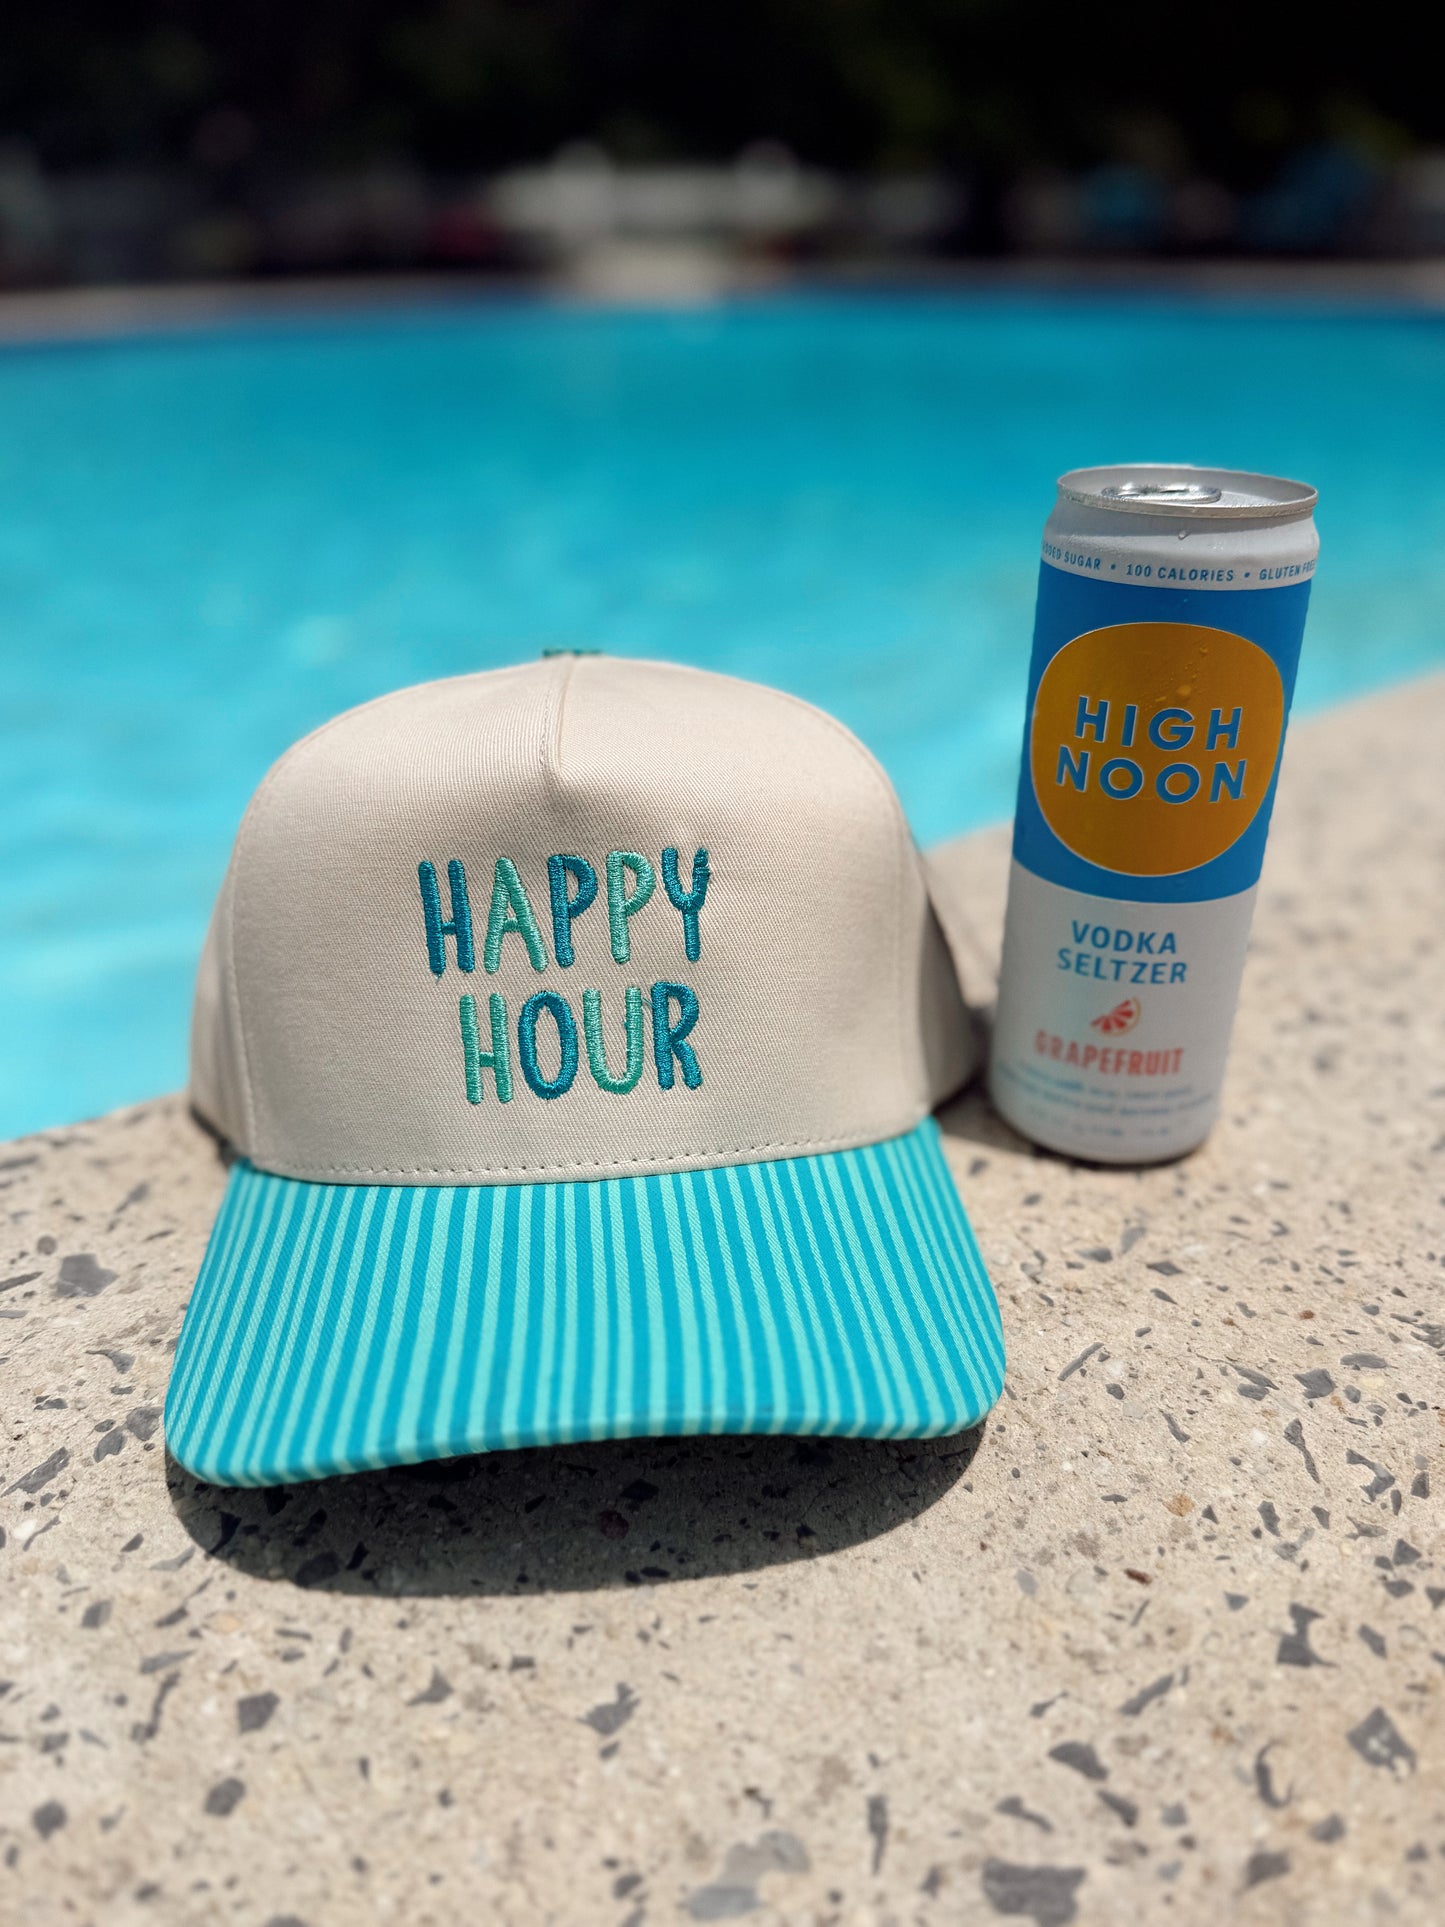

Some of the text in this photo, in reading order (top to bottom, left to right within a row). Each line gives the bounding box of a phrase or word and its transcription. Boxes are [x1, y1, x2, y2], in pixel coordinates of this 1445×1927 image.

[1064, 552, 1101, 570] SUGAR
[1126, 563, 1152, 577] 100
[1157, 566, 1234, 582] CALORIES
[1259, 564, 1300, 581] GLUTEN
[1074, 695, 1243, 751] HIGH
[1055, 744, 1247, 804] NOON
[418, 847, 710, 976] HAPPY
[1071, 919, 1177, 955] VODKA
[1056, 948, 1188, 985] SELTZER
[459, 981, 703, 1104] HOUR
[1035, 1030, 1184, 1076] GRAPEFRUIT
